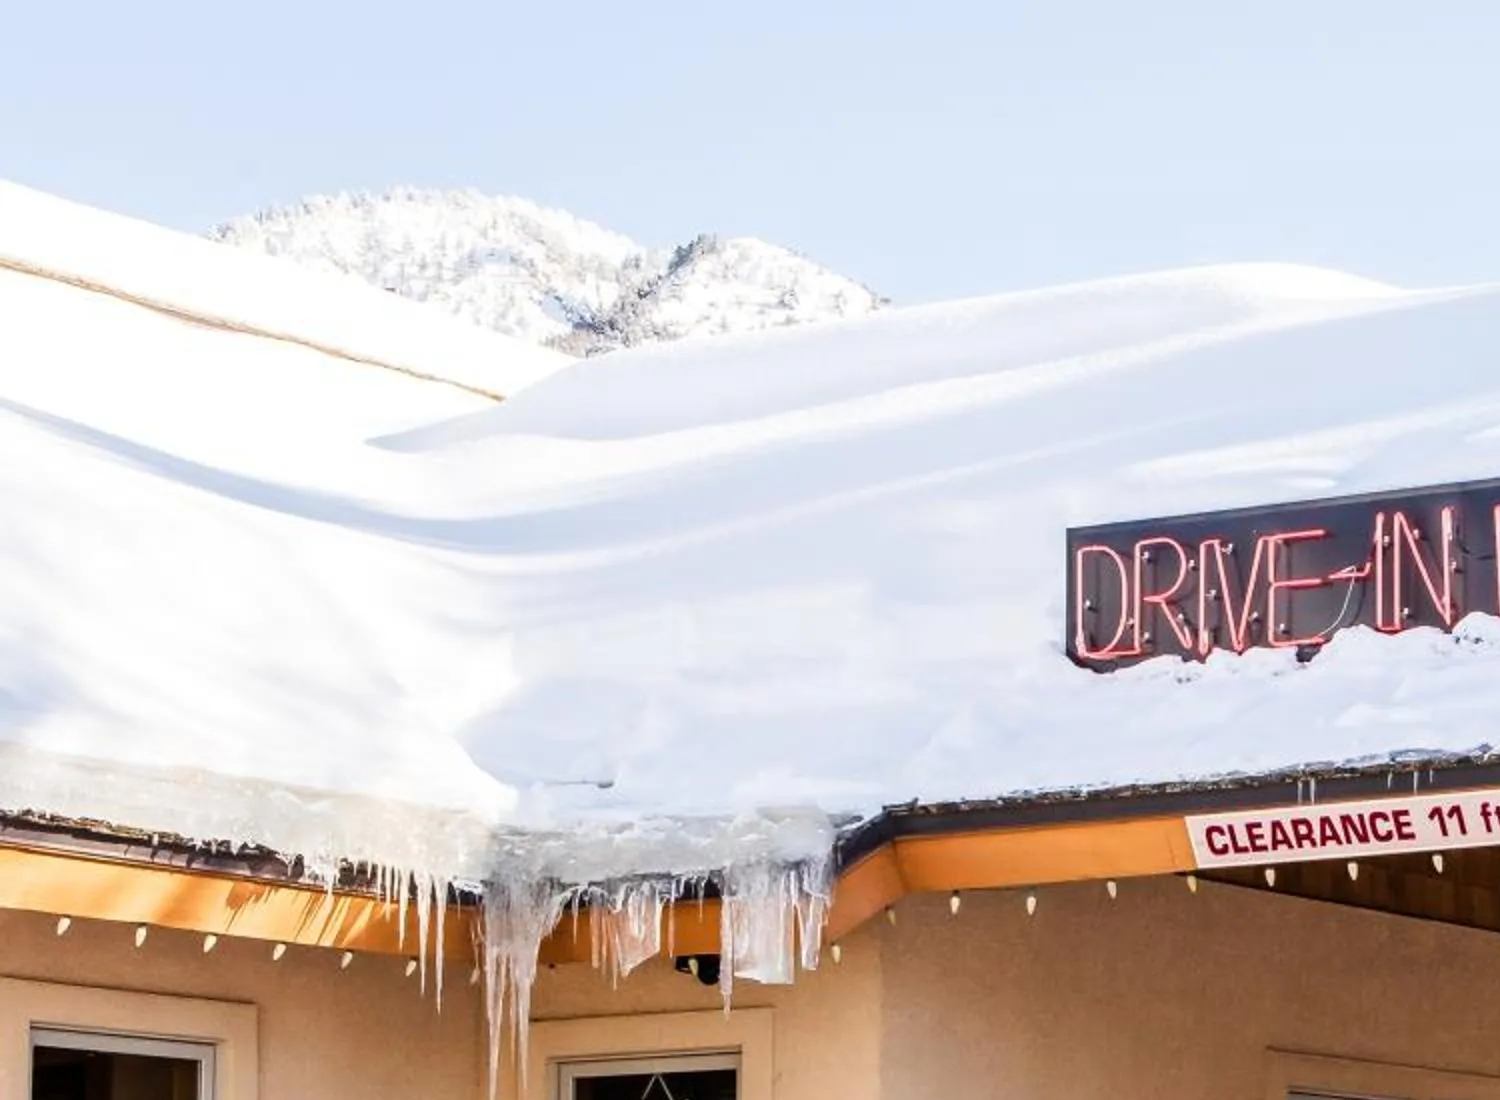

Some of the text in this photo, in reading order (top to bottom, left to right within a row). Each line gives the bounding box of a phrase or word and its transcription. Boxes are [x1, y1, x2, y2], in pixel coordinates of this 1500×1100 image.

[1074, 506, 1453, 659] DRIVE-IN
[1205, 809, 1416, 856] CLEARANCE
[1428, 804, 1468, 837] 11
